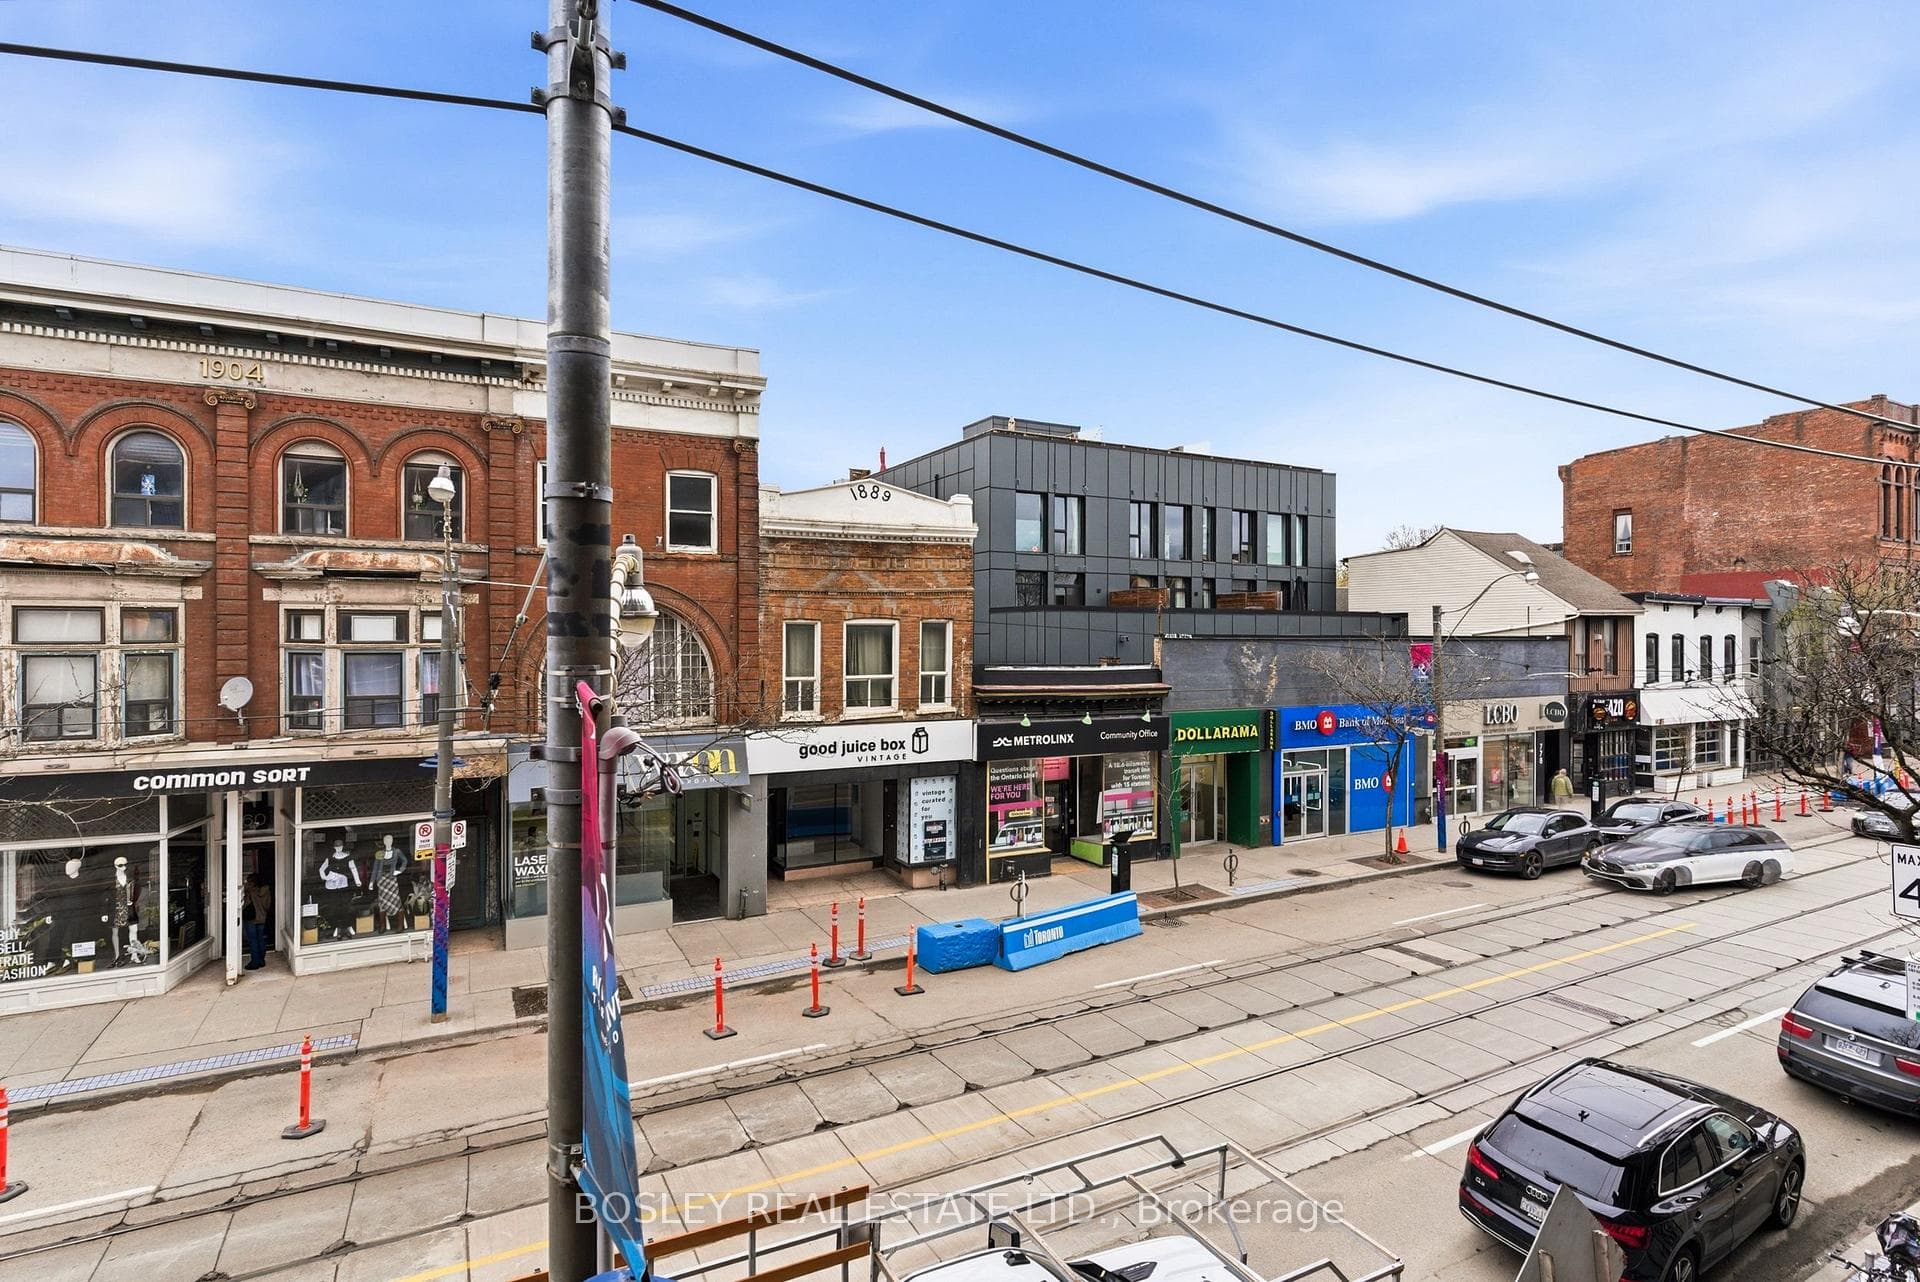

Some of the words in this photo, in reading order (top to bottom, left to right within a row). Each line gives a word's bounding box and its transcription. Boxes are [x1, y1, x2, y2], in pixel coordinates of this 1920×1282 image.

[200, 356, 264, 383] 1904
[850, 484, 892, 502] 1889
[1486, 703, 1520, 724] LCBO
[1545, 707, 1565, 717] LCBO
[1295, 719, 1317, 731] BMO
[1339, 717, 1360, 728] Bank
[1361, 716, 1371, 726] of
[1100, 730, 1138, 741] Community
[1138, 729, 1158, 738] Office
[1177, 724, 1259, 742] DOLLARAMA
[1013, 733, 1075, 746] METROLINX
[799, 741, 838, 759] good
[841, 739, 876, 757] juice
[881, 738, 906, 751] box
[857, 753, 907, 762] VINTAGE
[991, 766, 1019, 774] Questions
[1001, 773, 1023, 781] Ontario
[1354, 776, 1379, 790] BMO
[922, 789, 946, 797] vintage
[990, 784, 1013, 793] WE'RE
[990, 793, 1005, 801] FOR
[1005, 791, 1021, 799] YOU
[514, 854, 547, 867] LASE
[515, 864, 549, 877] WAXI
